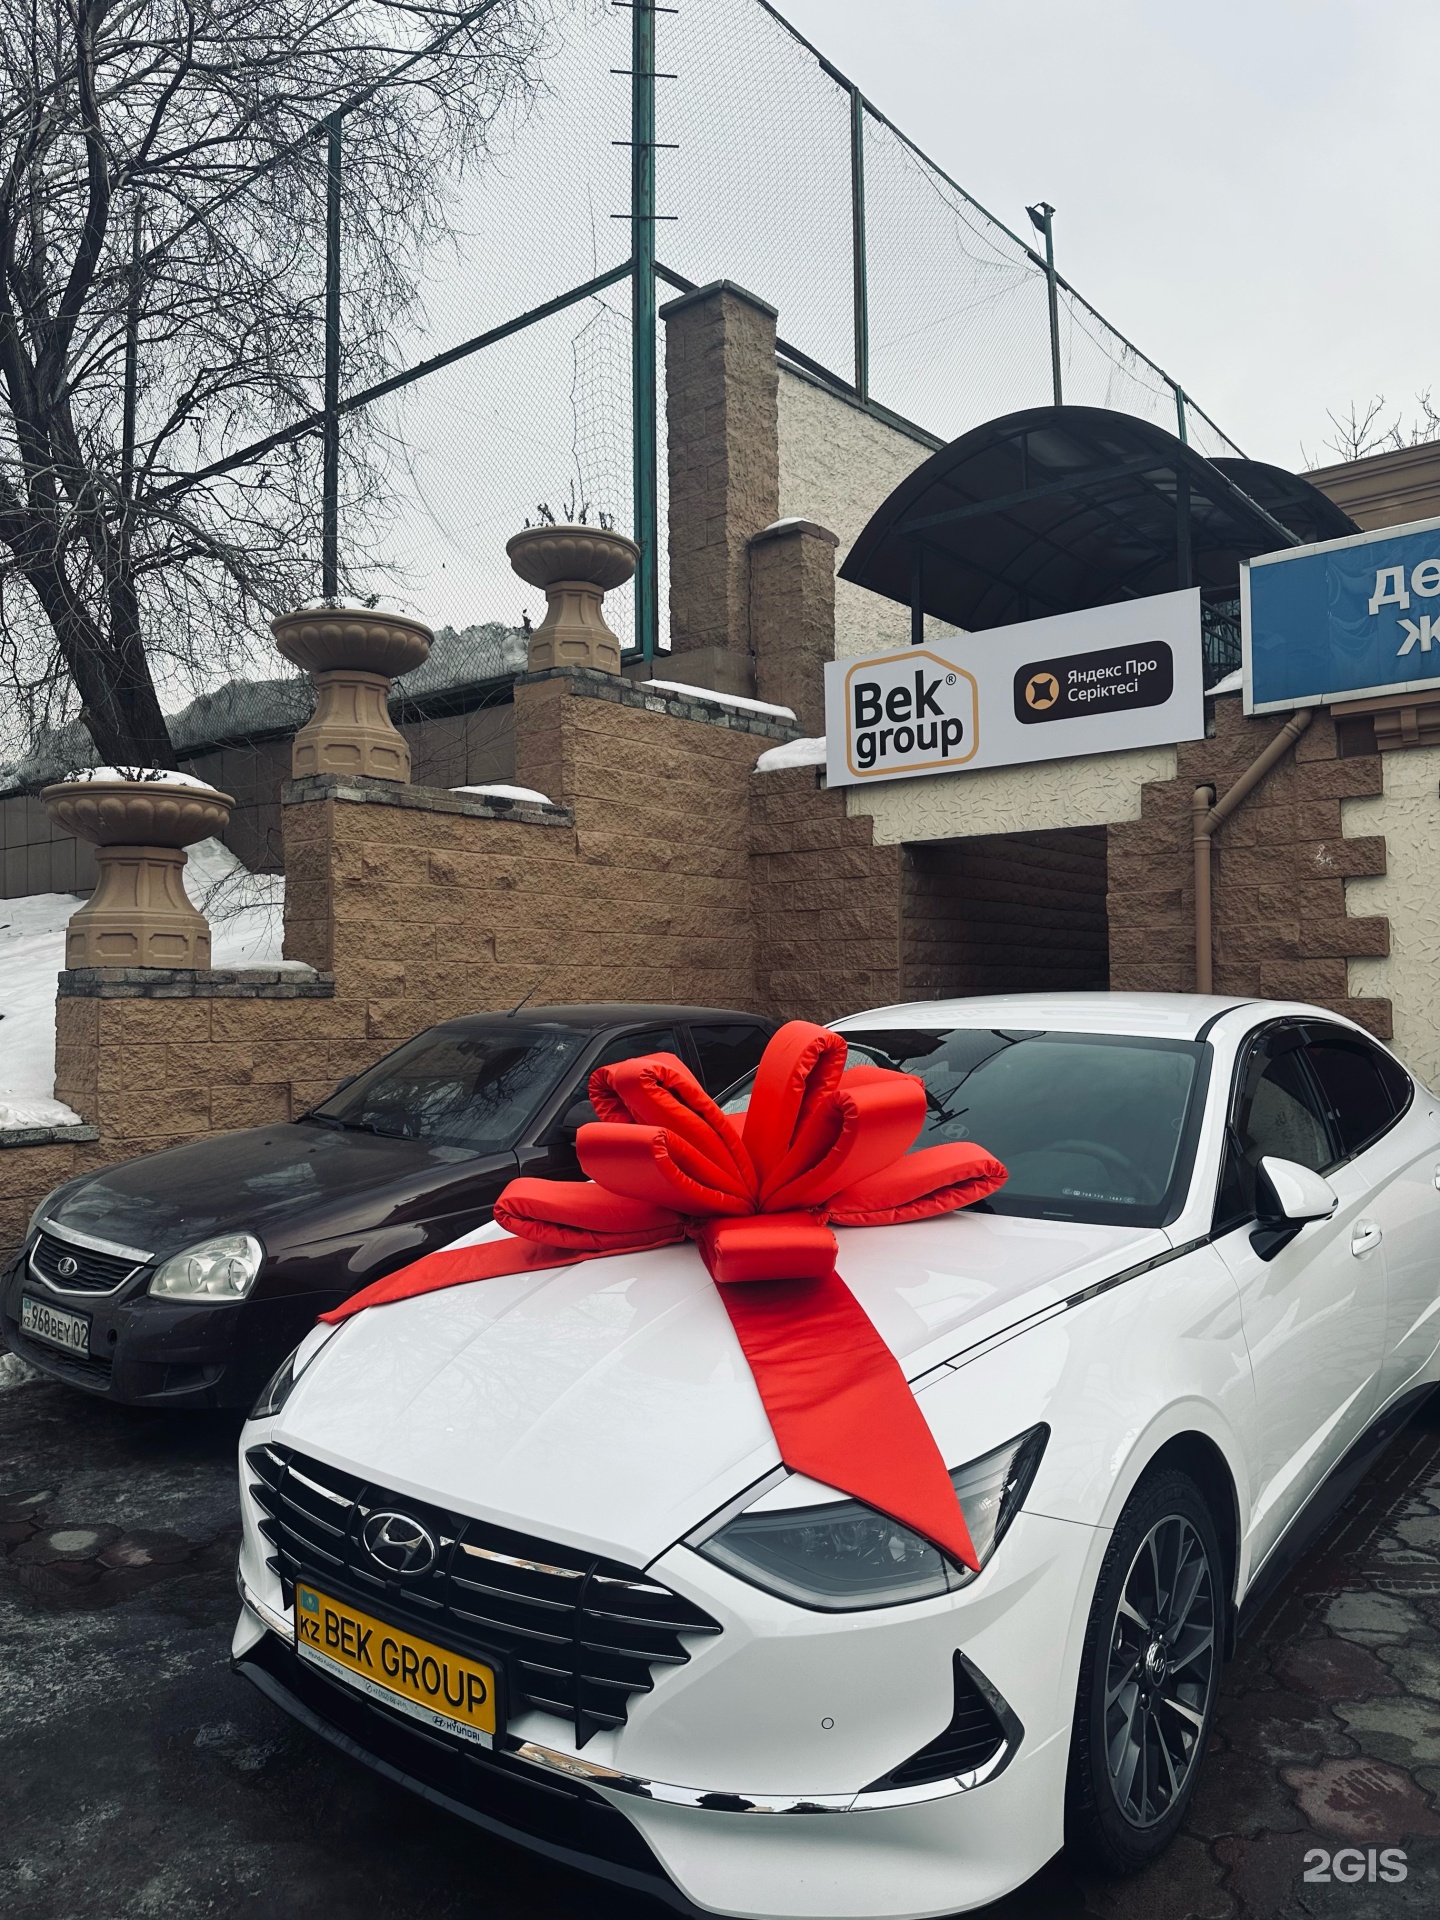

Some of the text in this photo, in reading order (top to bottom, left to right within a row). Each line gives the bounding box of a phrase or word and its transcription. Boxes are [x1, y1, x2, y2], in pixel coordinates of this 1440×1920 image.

[1067, 658, 1157, 684] Яндекс Про
[1067, 679, 1139, 702] Серіктесі
[856, 717, 964, 768] group
[300, 1615, 320, 1643] KZ
[325, 1608, 373, 1668] BEK
[381, 1638, 487, 1713] GROUP
[446, 1722, 480, 1741] HYUNDAI
